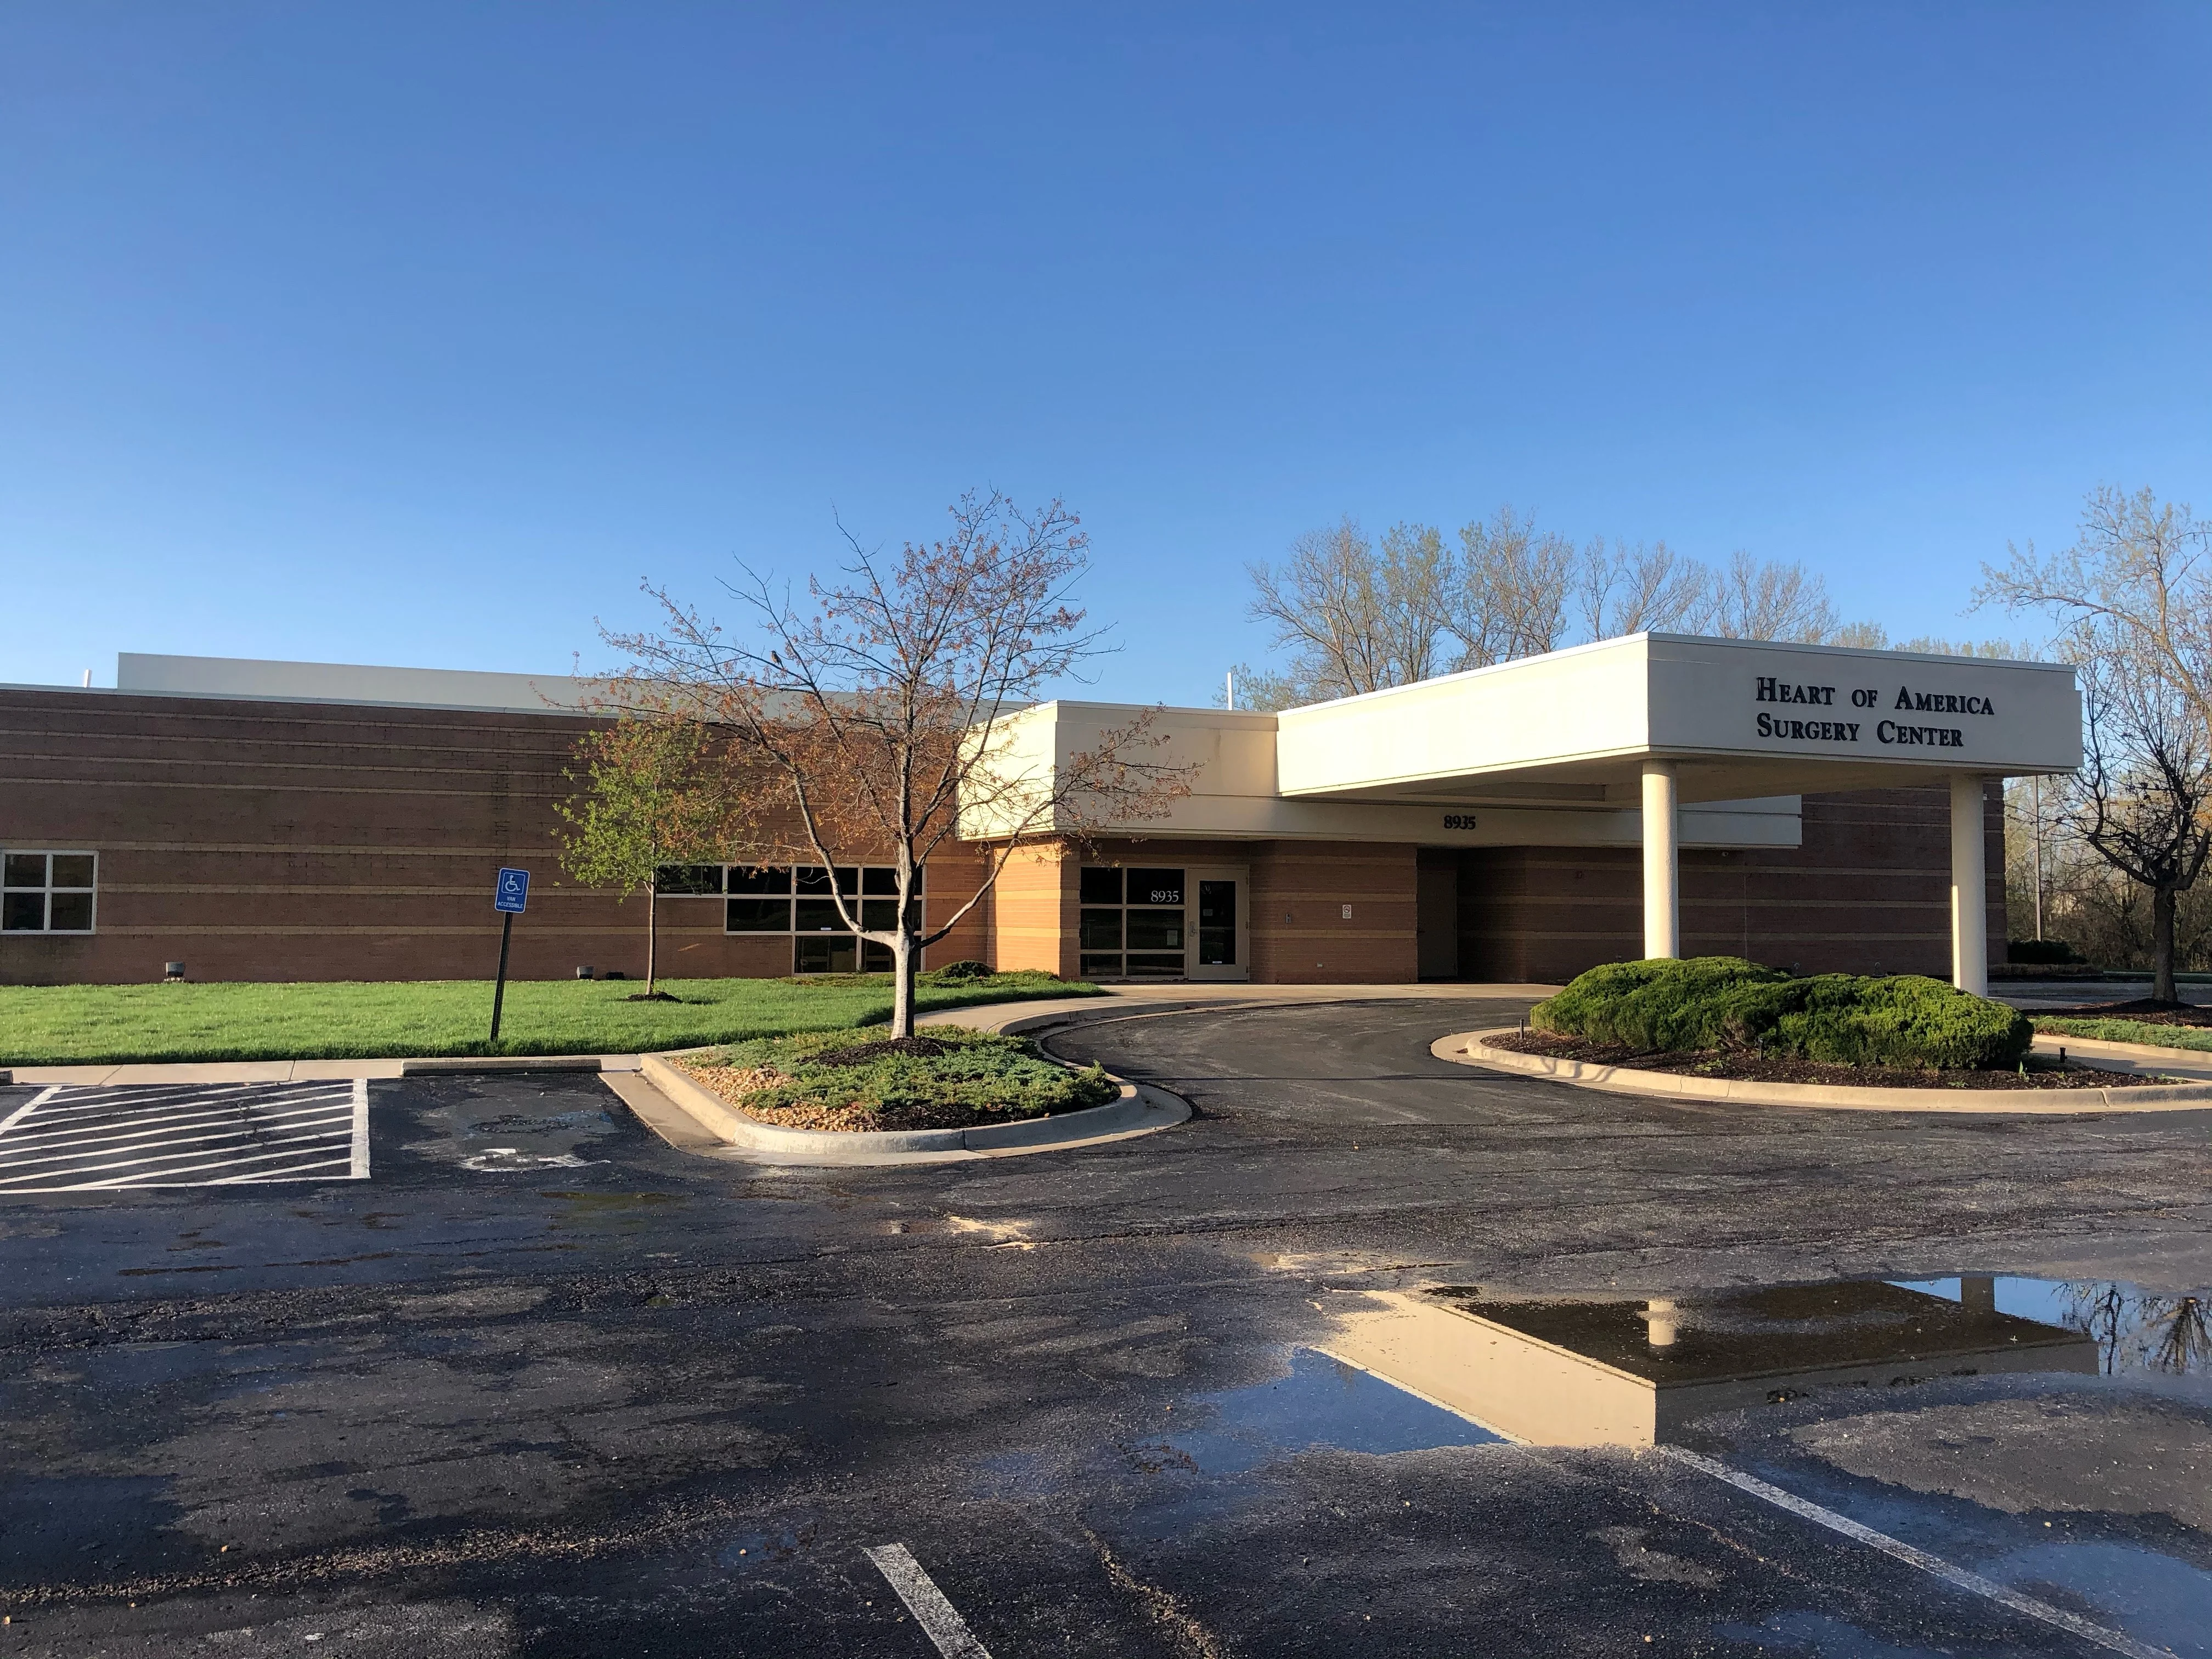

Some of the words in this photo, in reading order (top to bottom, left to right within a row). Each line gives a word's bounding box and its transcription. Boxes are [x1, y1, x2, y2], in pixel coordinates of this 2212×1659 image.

[1756, 676, 1835, 706] HEART
[1852, 689, 1878, 708] OF
[1894, 686, 1995, 715] AMERICA
[1757, 712, 1860, 741] SURGERY
[1877, 720, 1964, 747] CENTER
[1443, 815, 1476, 830] 8935
[1151, 890, 1179, 902] 8935
